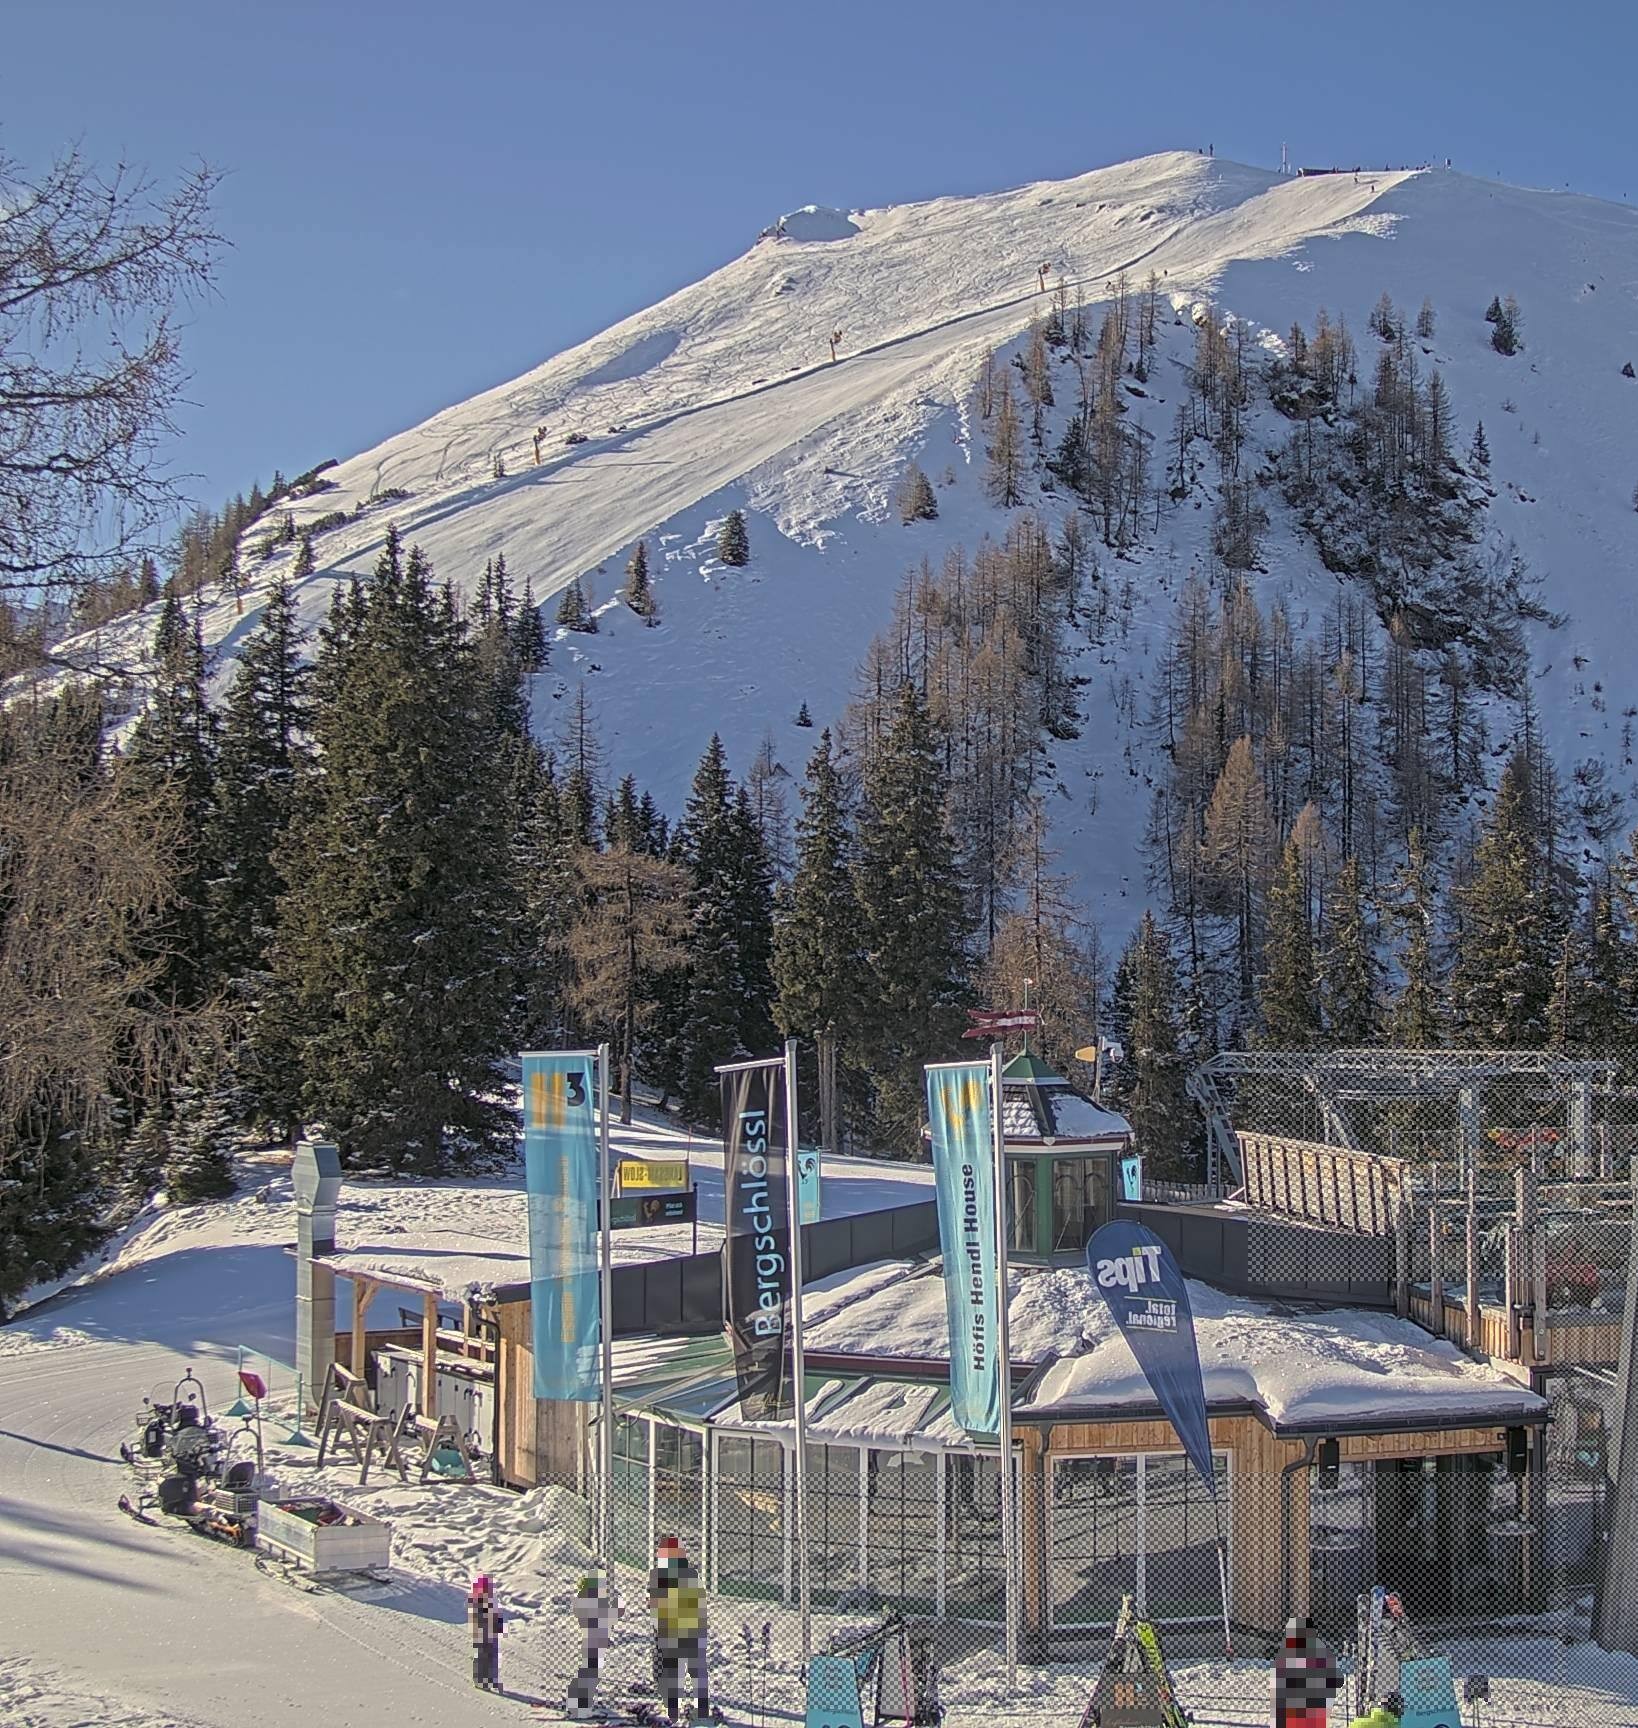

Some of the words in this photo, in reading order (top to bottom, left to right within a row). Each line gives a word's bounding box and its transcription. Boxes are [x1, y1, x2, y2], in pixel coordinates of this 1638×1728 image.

[739, 1108, 785, 1336] Bergschlössl
[961, 1163, 979, 1233] House
[966, 1240, 985, 1306] Hendl
